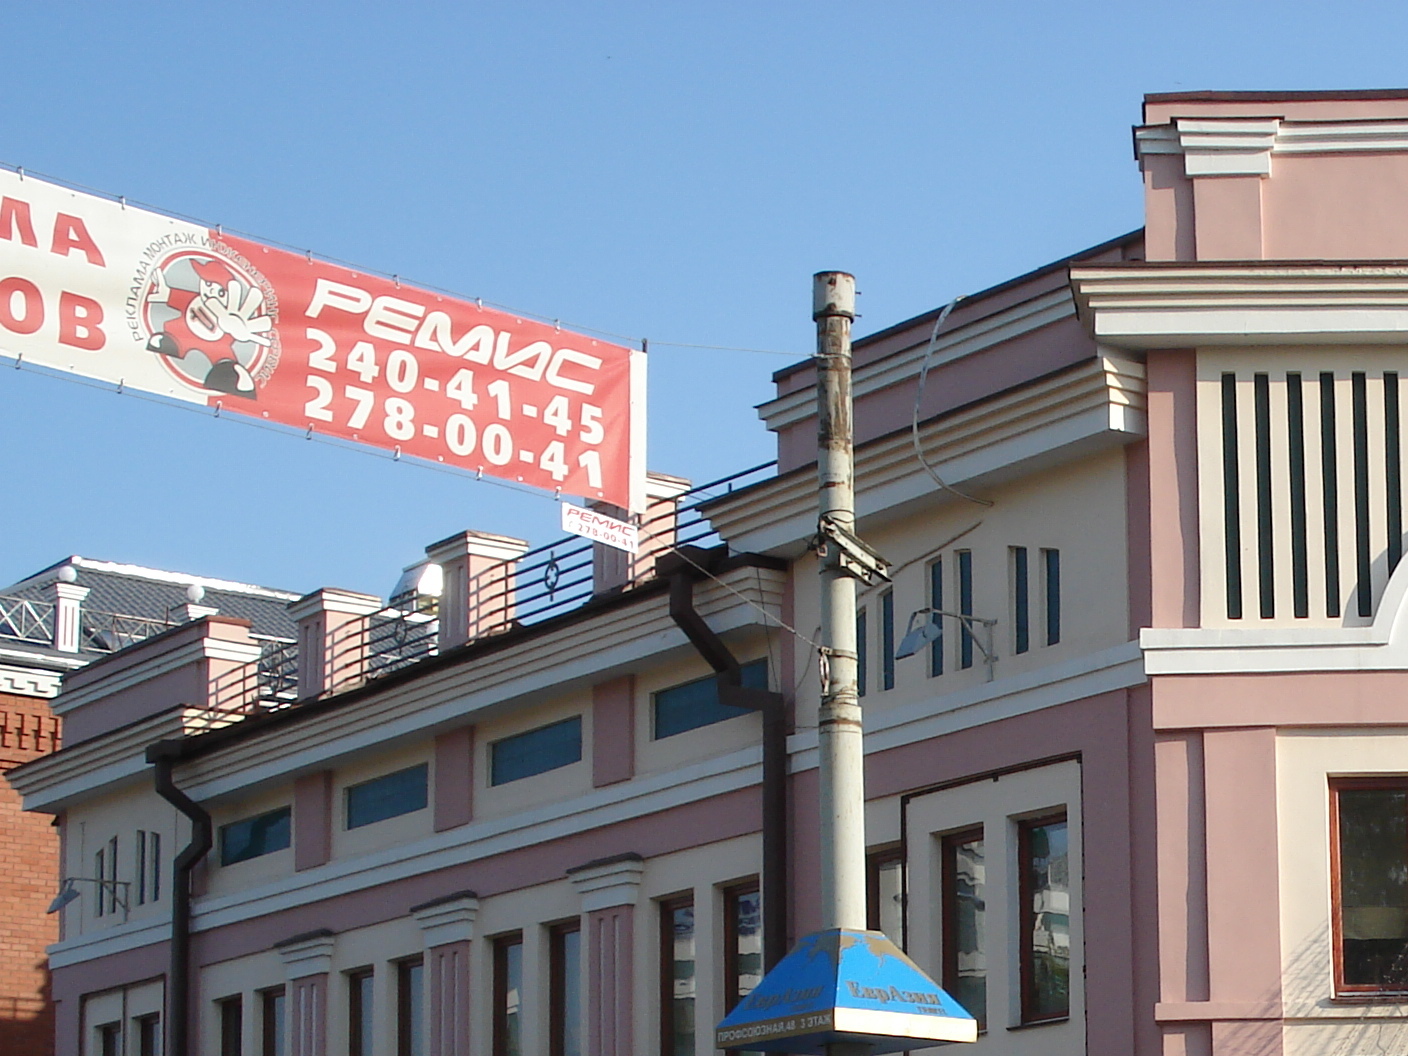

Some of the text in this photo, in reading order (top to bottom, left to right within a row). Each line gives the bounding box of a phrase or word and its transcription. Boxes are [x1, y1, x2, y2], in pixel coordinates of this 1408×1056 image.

[125, 259, 151, 342] РЕКЛАМА
[143, 232, 197, 262] МОНТАЖ
[304, 278, 603, 396] РЕМИС
[304, 374, 603, 489] 278-00-41
[305, 327, 605, 446] 240-41-45
[566, 508, 636, 537] РЕМИС
